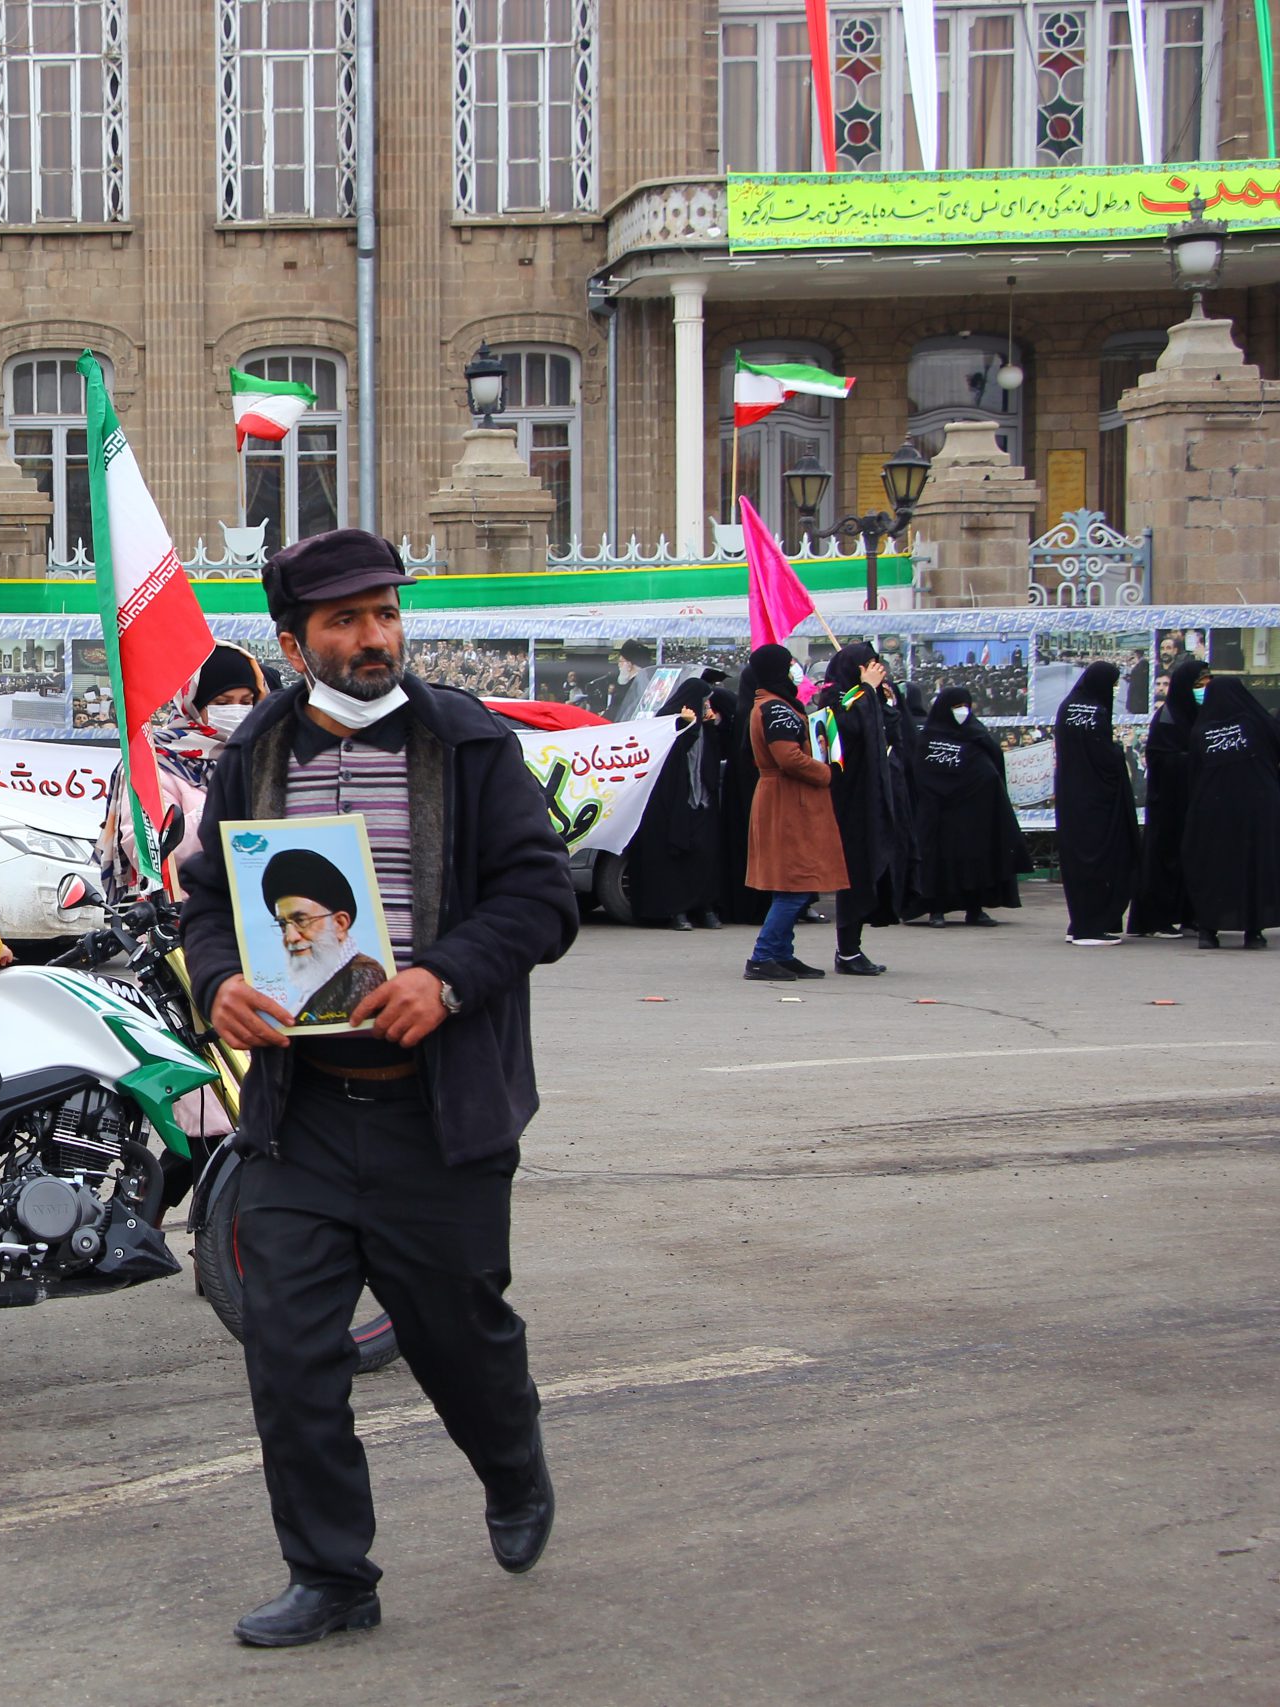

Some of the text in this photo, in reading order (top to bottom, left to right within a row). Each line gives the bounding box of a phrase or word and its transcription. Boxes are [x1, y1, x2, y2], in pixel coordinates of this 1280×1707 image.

[742, 190, 775, 226] گیرد
[880, 190, 951, 223] آینده
[970, 188, 999, 223] نسل
[1047, 183, 1085, 219] زندگی
[571, 735, 650, 783] پشتیبان
